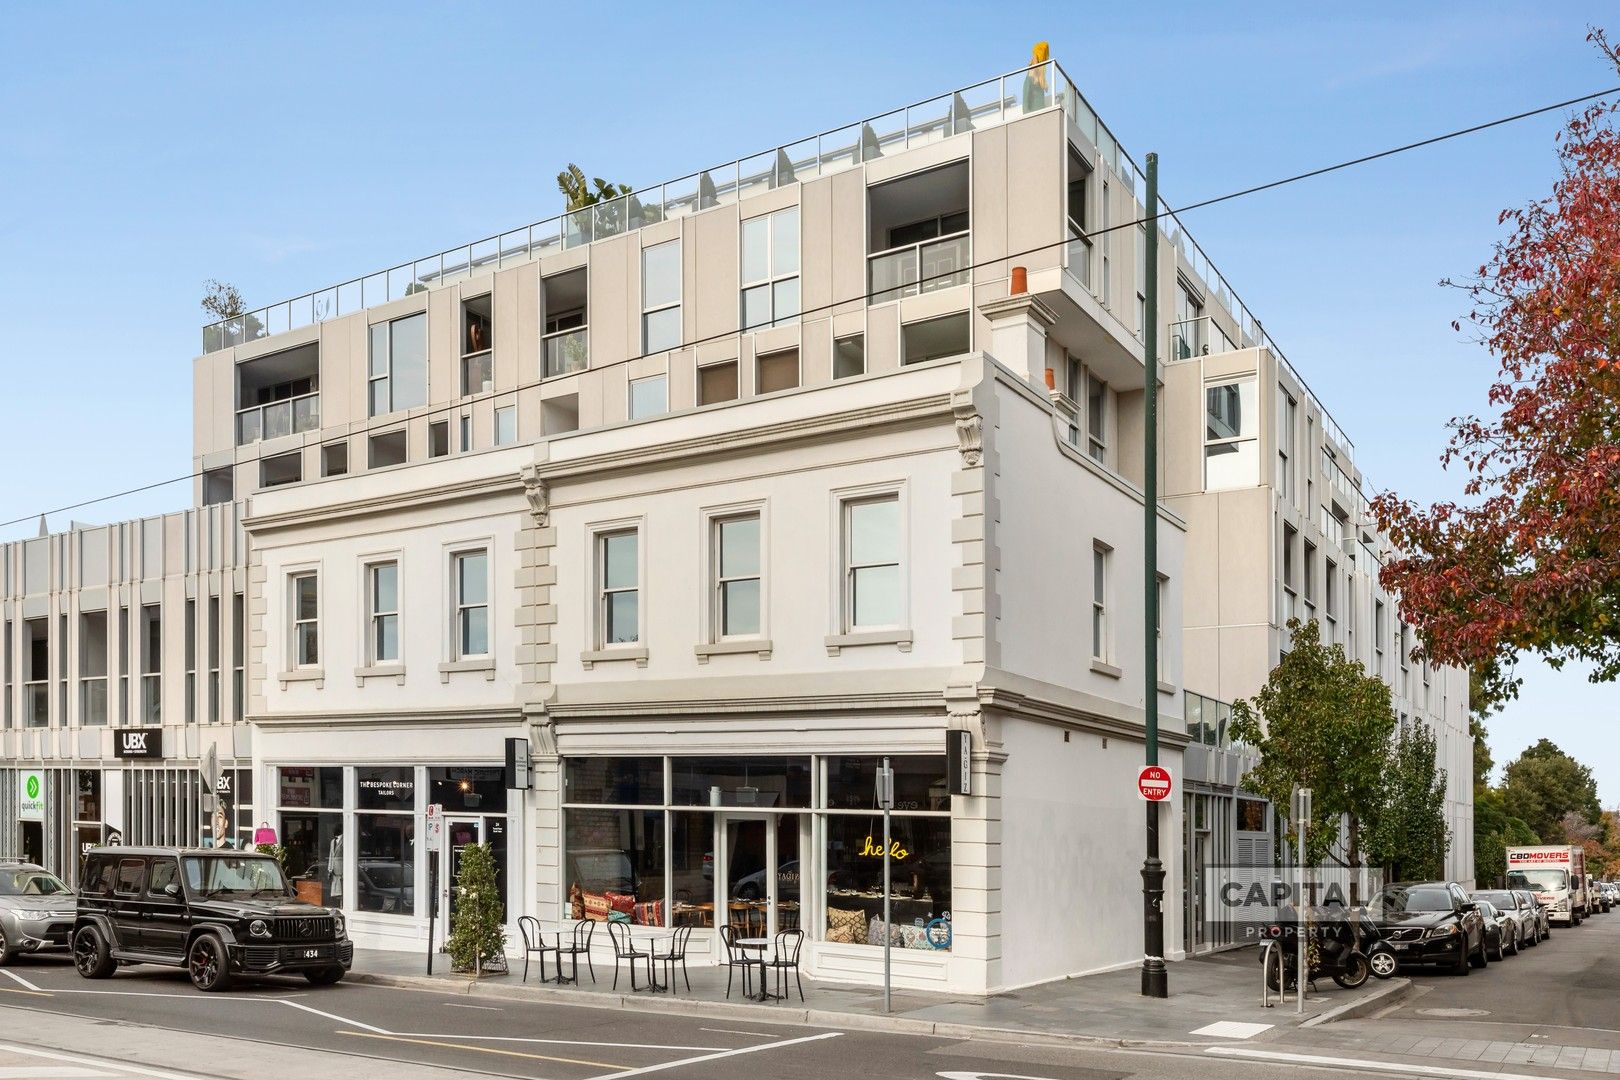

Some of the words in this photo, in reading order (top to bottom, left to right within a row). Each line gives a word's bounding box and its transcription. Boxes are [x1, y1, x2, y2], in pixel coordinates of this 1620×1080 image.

[123, 733, 147, 749] UBX
[1143, 788, 1166, 796] ENTRY
[21, 801, 44, 812] quickfit
